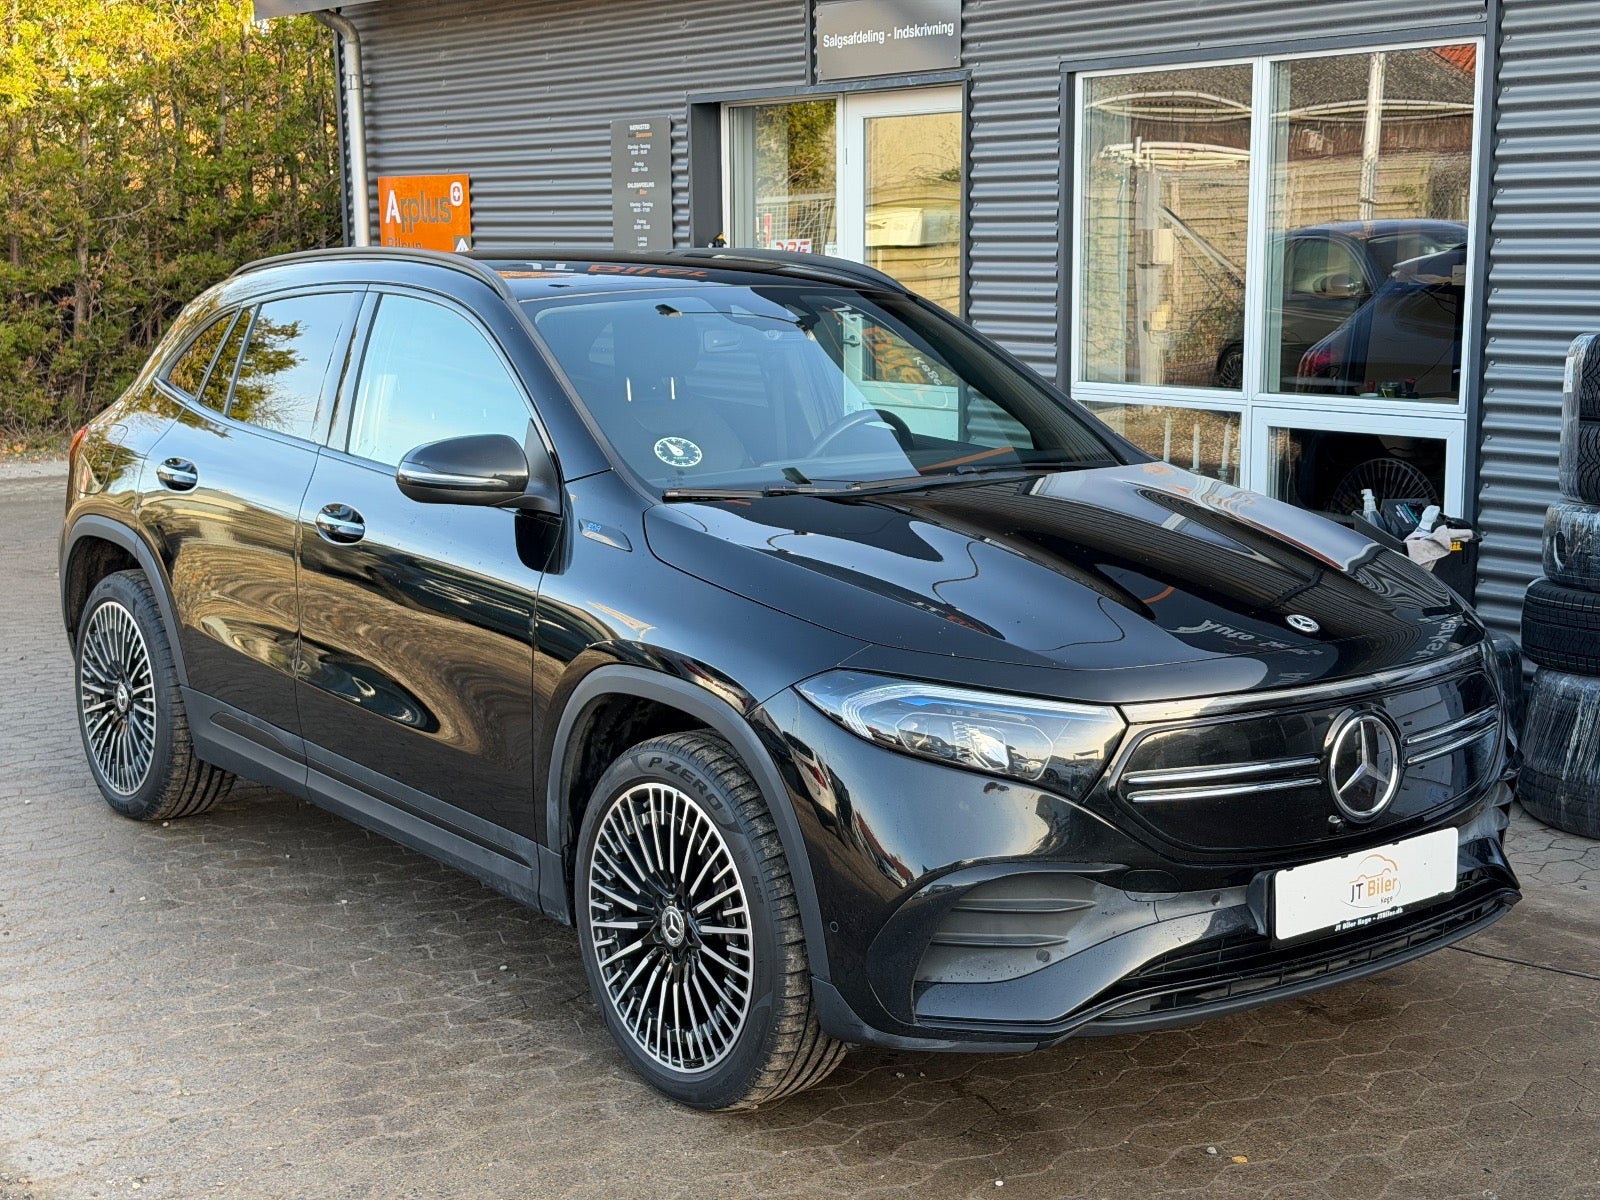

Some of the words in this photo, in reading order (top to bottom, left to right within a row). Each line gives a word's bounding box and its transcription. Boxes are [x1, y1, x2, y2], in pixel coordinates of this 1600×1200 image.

[823, 30, 885, 48] Salgsafdeling
[894, 21, 954, 39] Indskrivning
[647, 756, 663, 769] P
[664, 760, 724, 812] ZERO
[1350, 882, 1364, 903] JT
[1367, 876, 1398, 897] Biler
